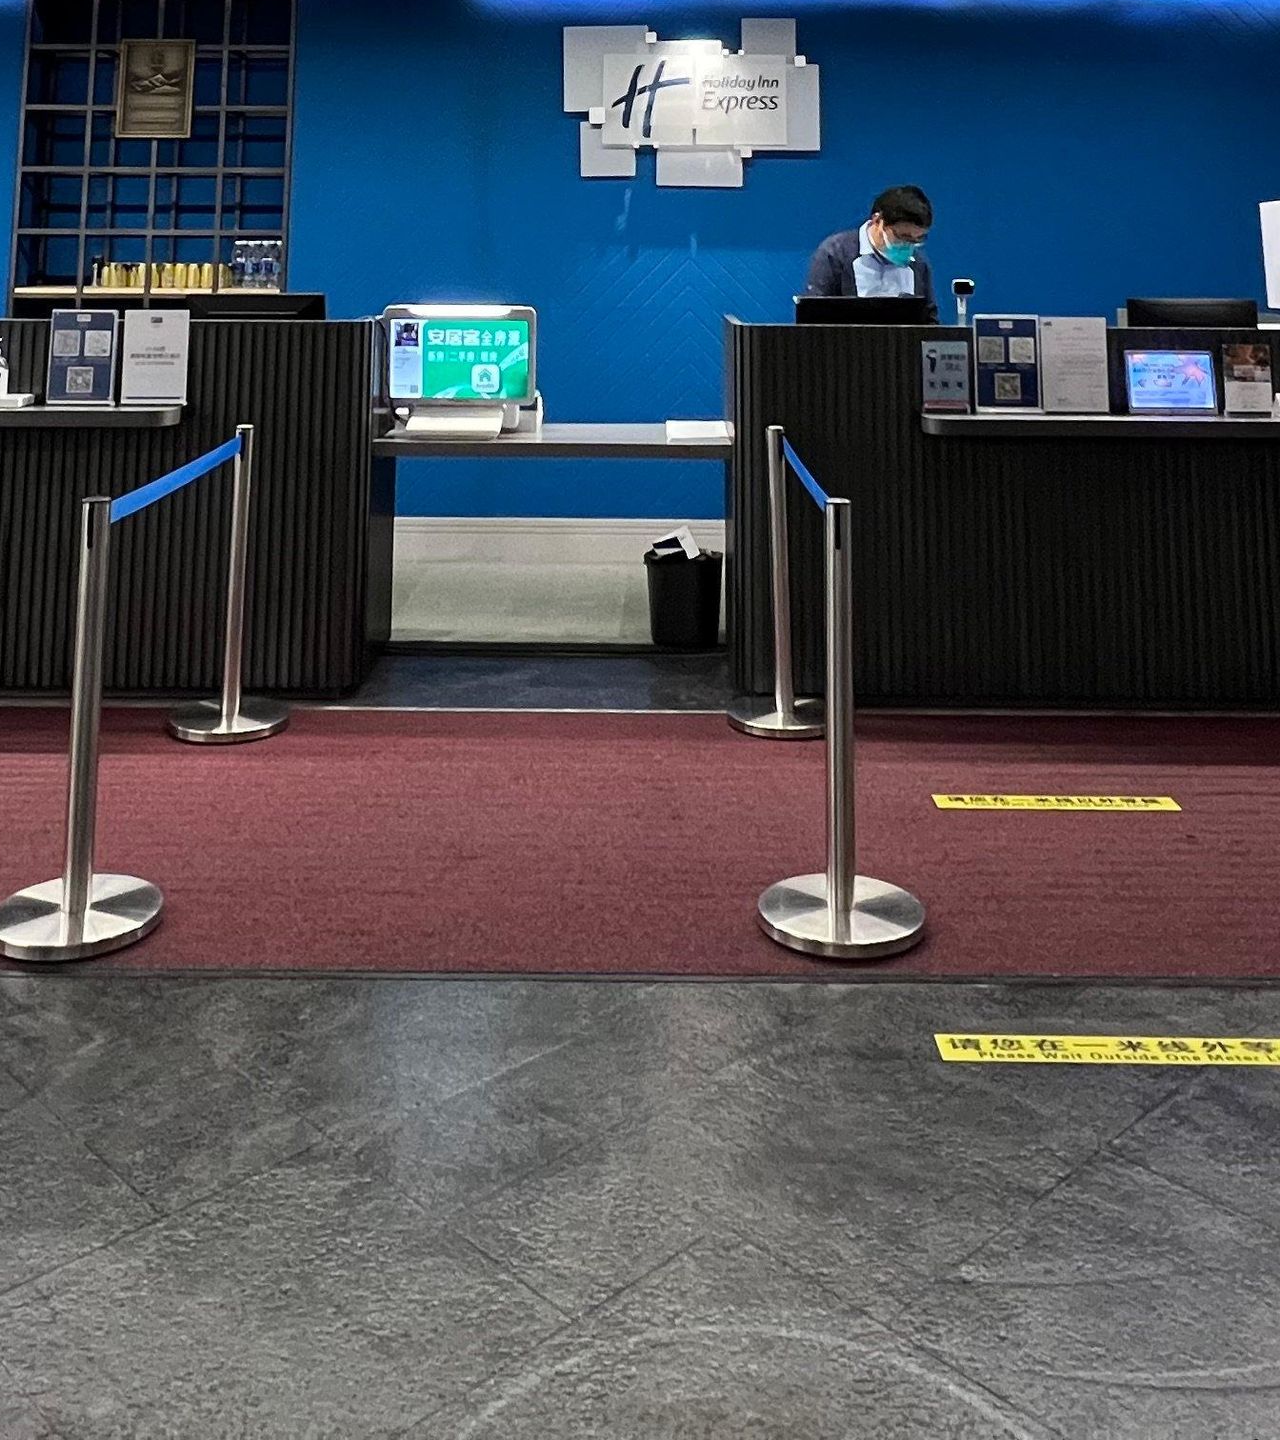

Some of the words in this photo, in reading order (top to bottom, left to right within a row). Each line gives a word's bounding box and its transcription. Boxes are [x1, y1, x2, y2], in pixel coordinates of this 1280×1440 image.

[701, 75, 755, 92] Holiday
[757, 74, 779, 89] Inn
[701, 91, 780, 114] Express
[978, 1051, 1035, 1059] Please
[1090, 1053, 1159, 1061] Outside
[1208, 1054, 1259, 1062] Meter
